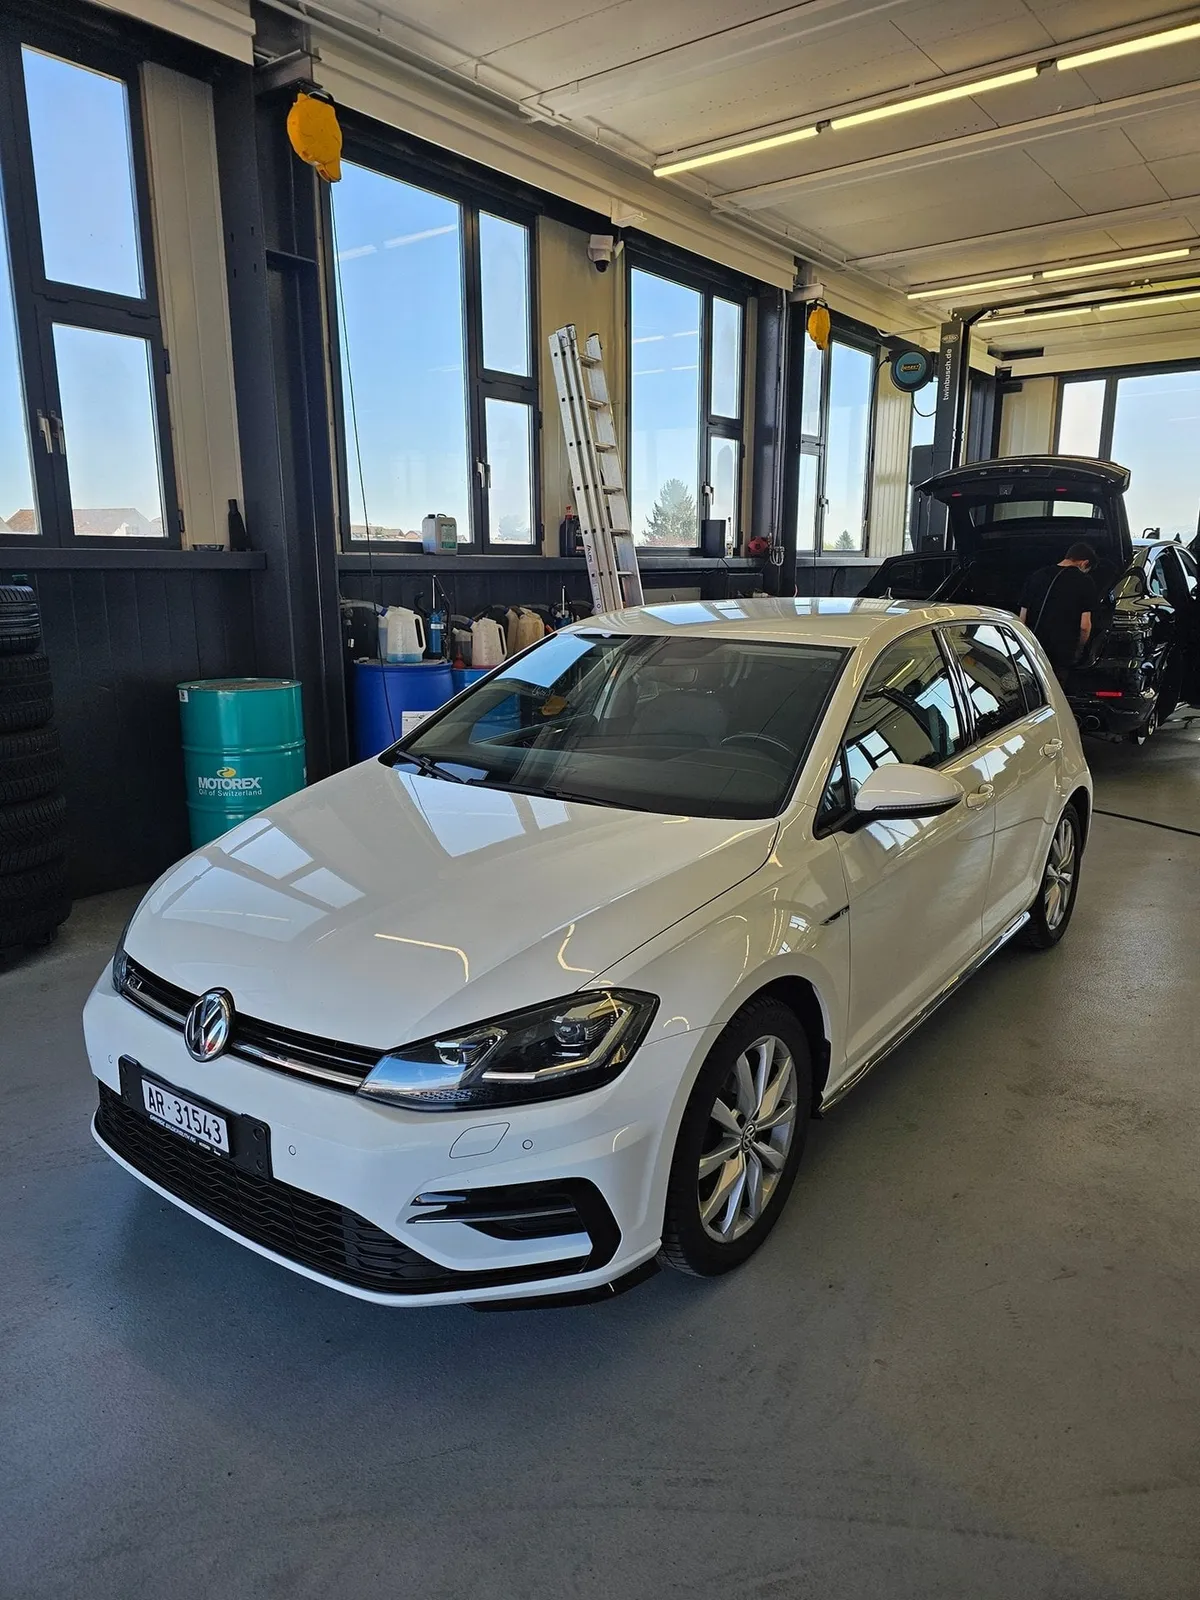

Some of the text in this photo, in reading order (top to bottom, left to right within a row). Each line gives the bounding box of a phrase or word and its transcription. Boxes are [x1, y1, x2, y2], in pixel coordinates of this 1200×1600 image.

[943, 348, 953, 401] twinbusch.de
[198, 777, 261, 790] MOTOREX
[198, 788, 208, 796] Oil
[217, 789, 262, 797] Switzerland
